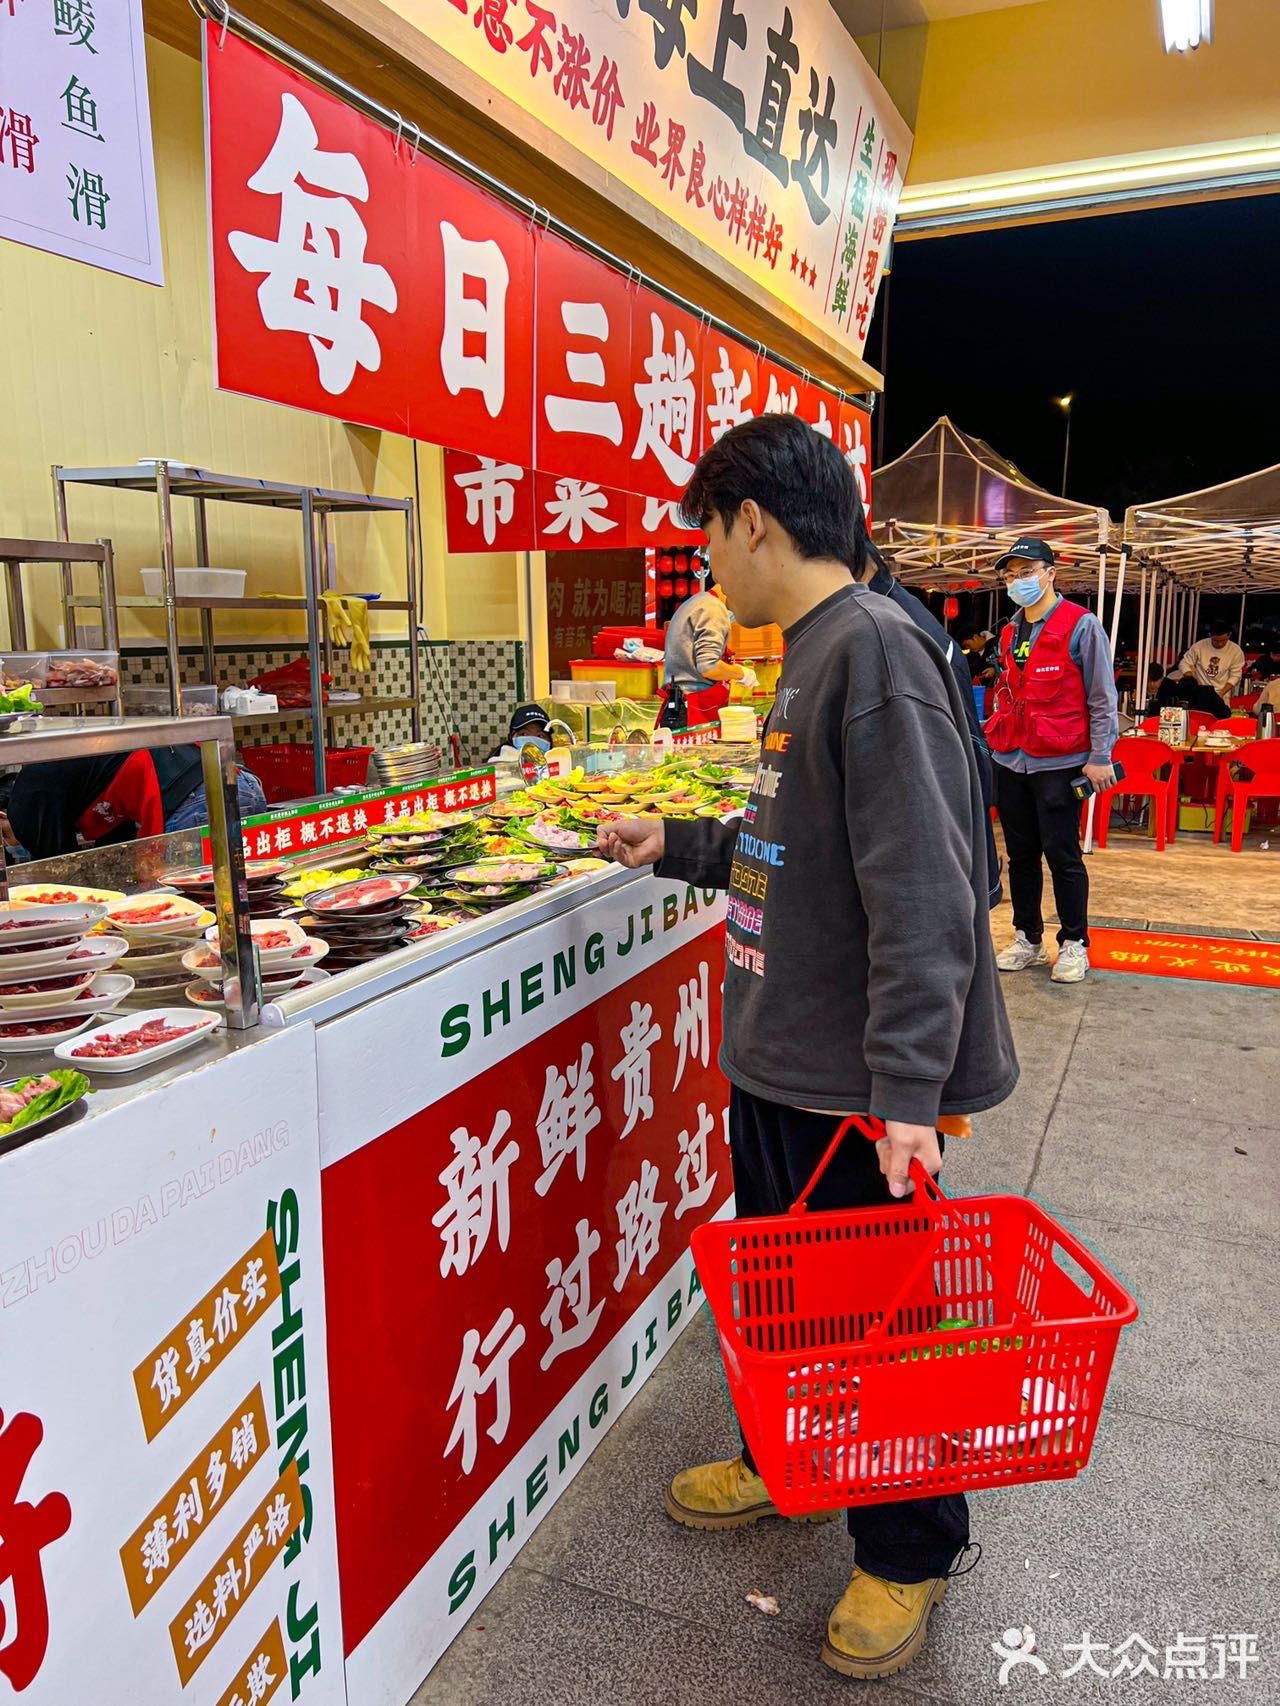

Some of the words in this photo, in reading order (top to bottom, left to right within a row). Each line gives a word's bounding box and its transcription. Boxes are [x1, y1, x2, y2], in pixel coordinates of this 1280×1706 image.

[448, 0, 625, 141] 意不涨价
[630, 101, 783, 270] 业界良心样样好
[300, 809, 368, 845] 概不退换
[384, 794, 439, 824] 菜品出柜
[443, 779, 493, 808] 概不退换
[440, 931, 605, 1059] SHENG
[617, 904, 654, 958] JI
[431, 961, 725, 1279] 新鲜贵州
[0, 1218, 108, 1309] ZHOU
[112, 1194, 158, 1246] DA
[161, 1160, 216, 1218] PAI
[219, 1120, 289, 1185] DANG
[443, 1102, 730, 1476] 行过路过
[149, 1257, 269, 1414] 货真价实
[139, 1410, 259, 1585] 薄利多销
[447, 1382, 609, 1616] SHENG
[621, 1316, 658, 1389] JI
[183, 1491, 294, 1659] 选料严格
[286, 1580, 322, 1703] JI
[228, 1653, 277, 1706] 欺
